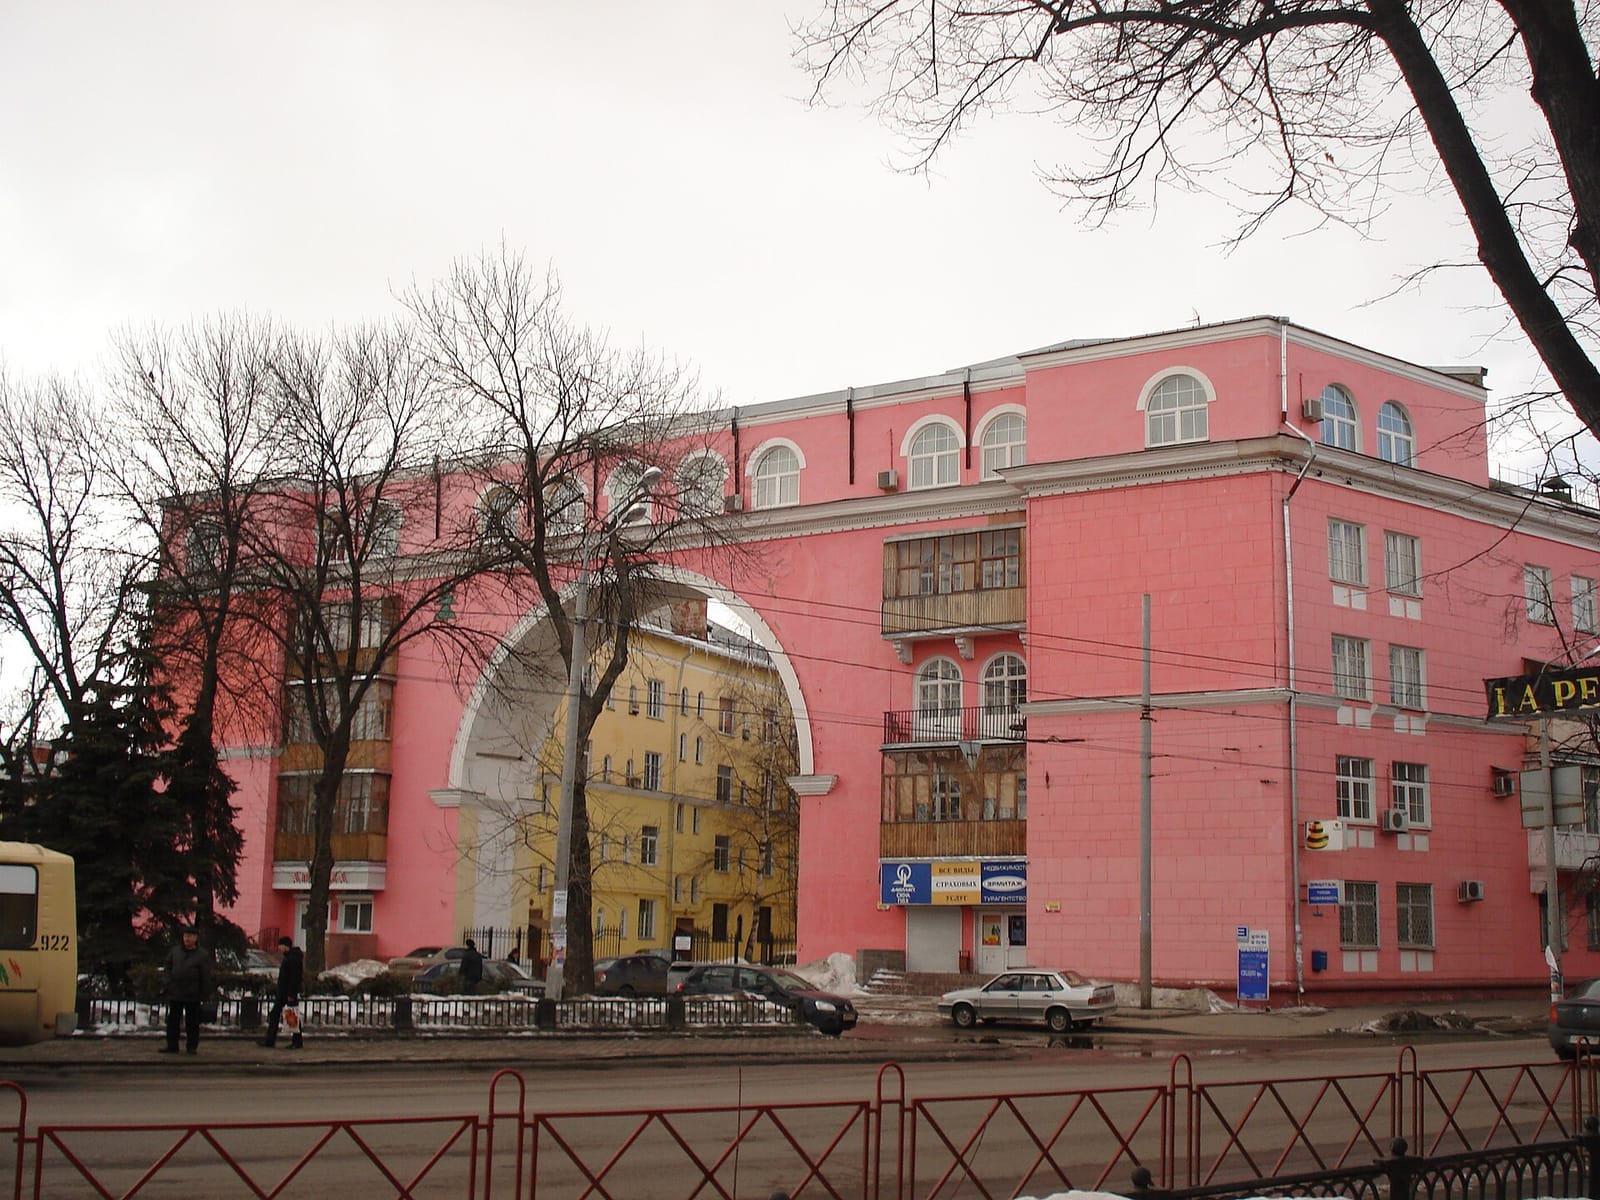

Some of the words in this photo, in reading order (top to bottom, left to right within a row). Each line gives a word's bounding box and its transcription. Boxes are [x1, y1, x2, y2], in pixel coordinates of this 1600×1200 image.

[1494, 683, 1542, 718] LA
[983, 864, 1026, 872] НЕДВИЖИМОСТ
[935, 880, 977, 888] СТРАХОВЫХ
[987, 880, 1023, 888] ЭРМИТАЖ
[41, 935, 69, 951] 922
